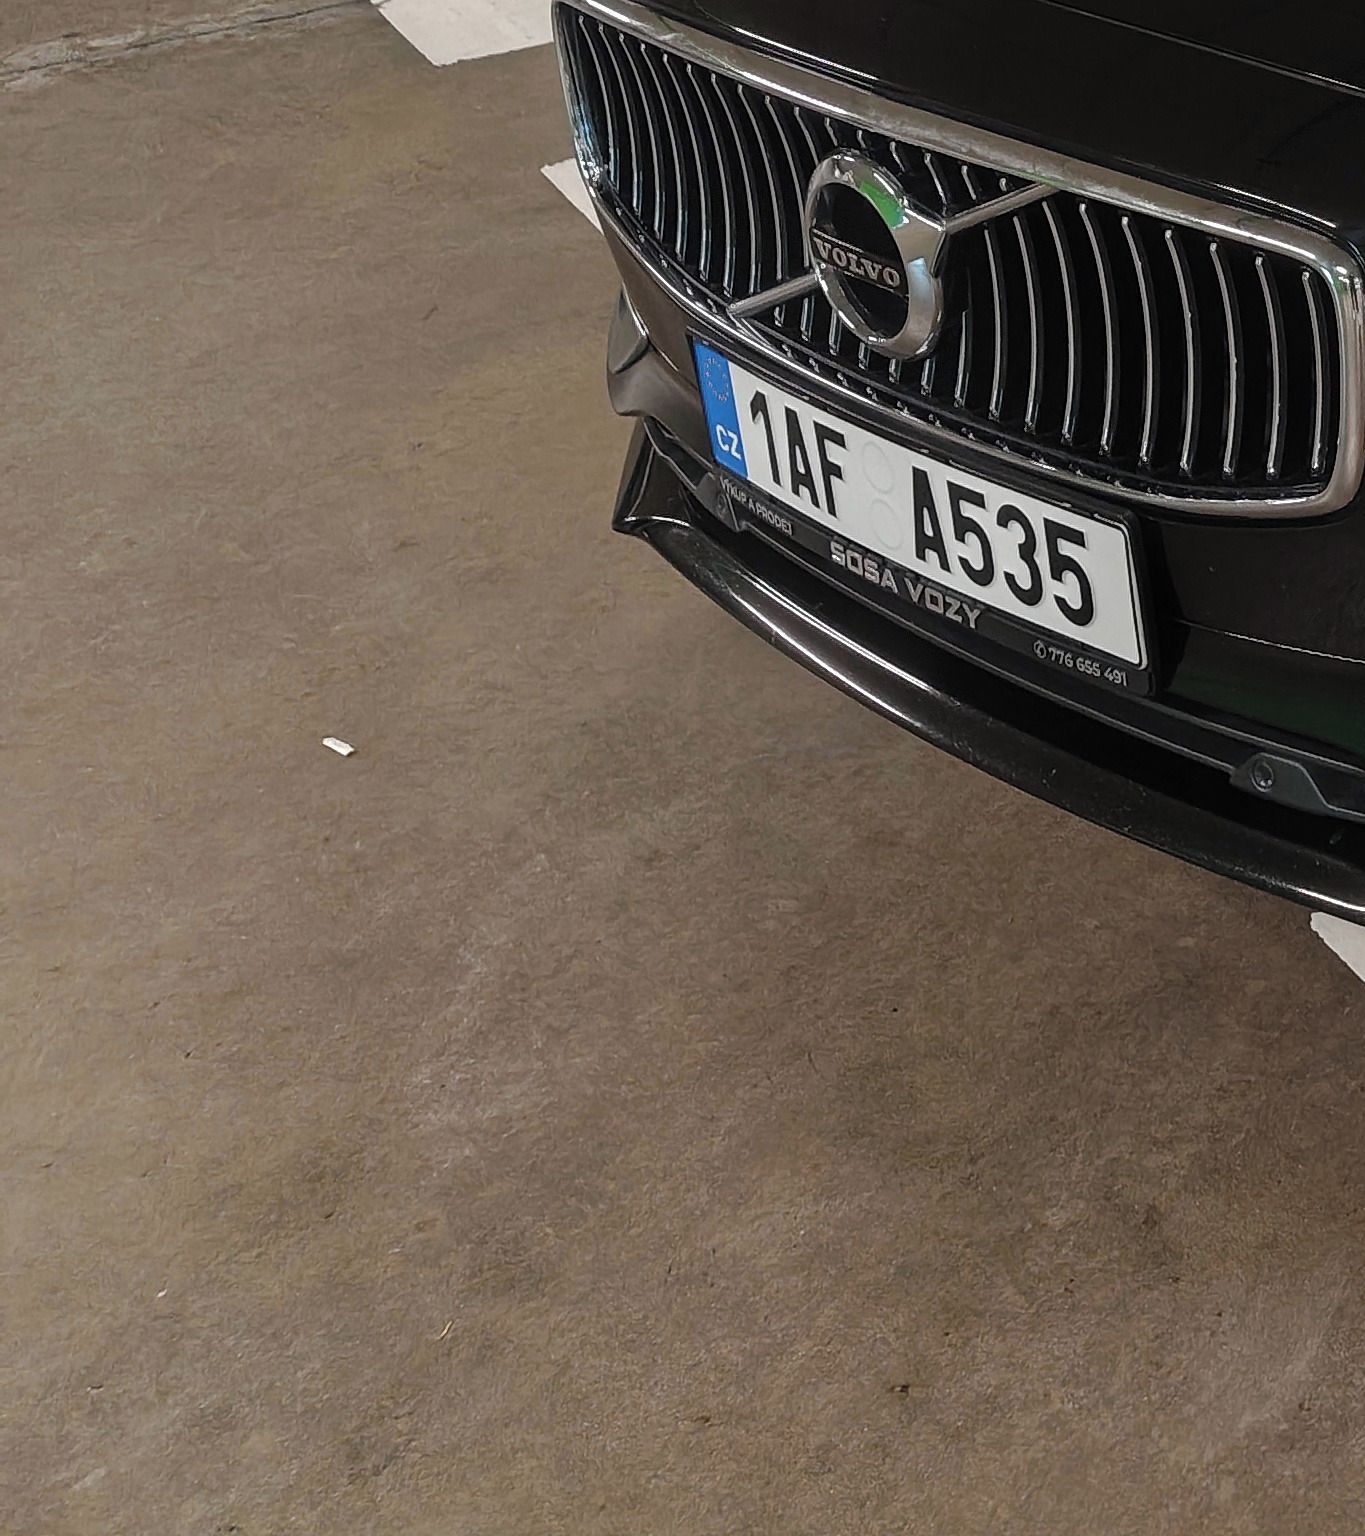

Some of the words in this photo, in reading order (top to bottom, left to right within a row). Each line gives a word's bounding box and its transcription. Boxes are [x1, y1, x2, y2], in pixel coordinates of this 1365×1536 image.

[813, 237, 900, 288] VOLVO
[716, 425, 742, 459] CZ
[750, 390, 847, 519] 1AF
[912, 465, 1096, 628] A535
[904, 576, 981, 629] VOZY
[1048, 647, 1074, 668] 776
[1076, 658, 1101, 677] 655
[1104, 667, 1127, 687] 491
